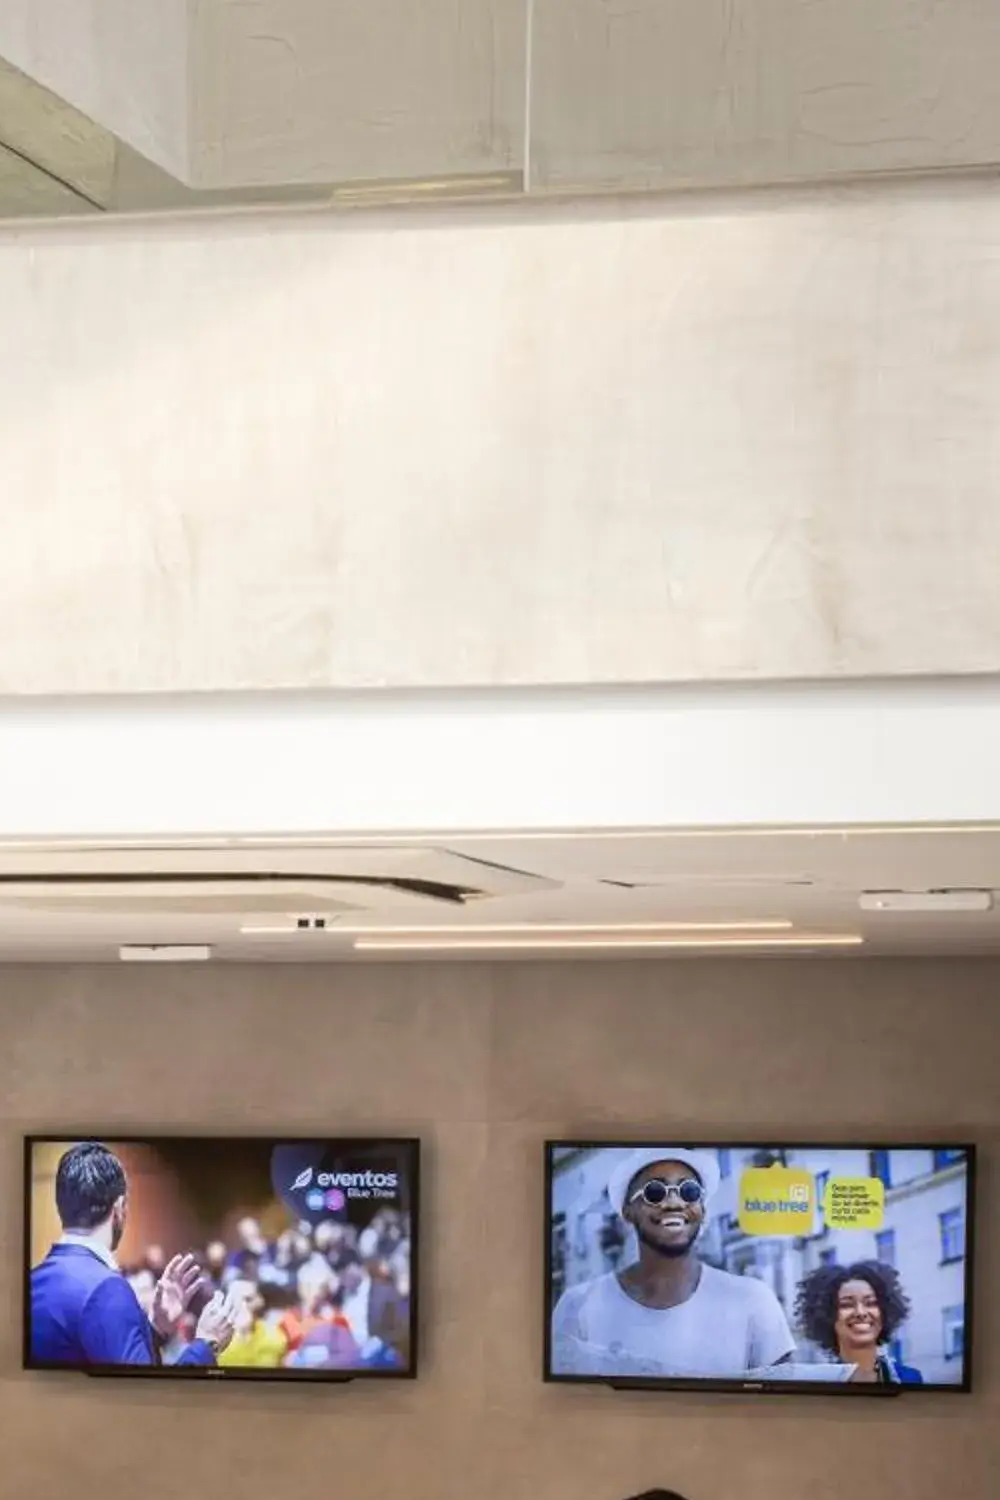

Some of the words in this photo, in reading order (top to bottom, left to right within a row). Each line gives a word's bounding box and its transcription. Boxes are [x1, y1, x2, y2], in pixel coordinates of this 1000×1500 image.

[317, 1170, 397, 1187] eventos
[744, 1197, 776, 1213] blue
[778, 1199, 809, 1213] tree
